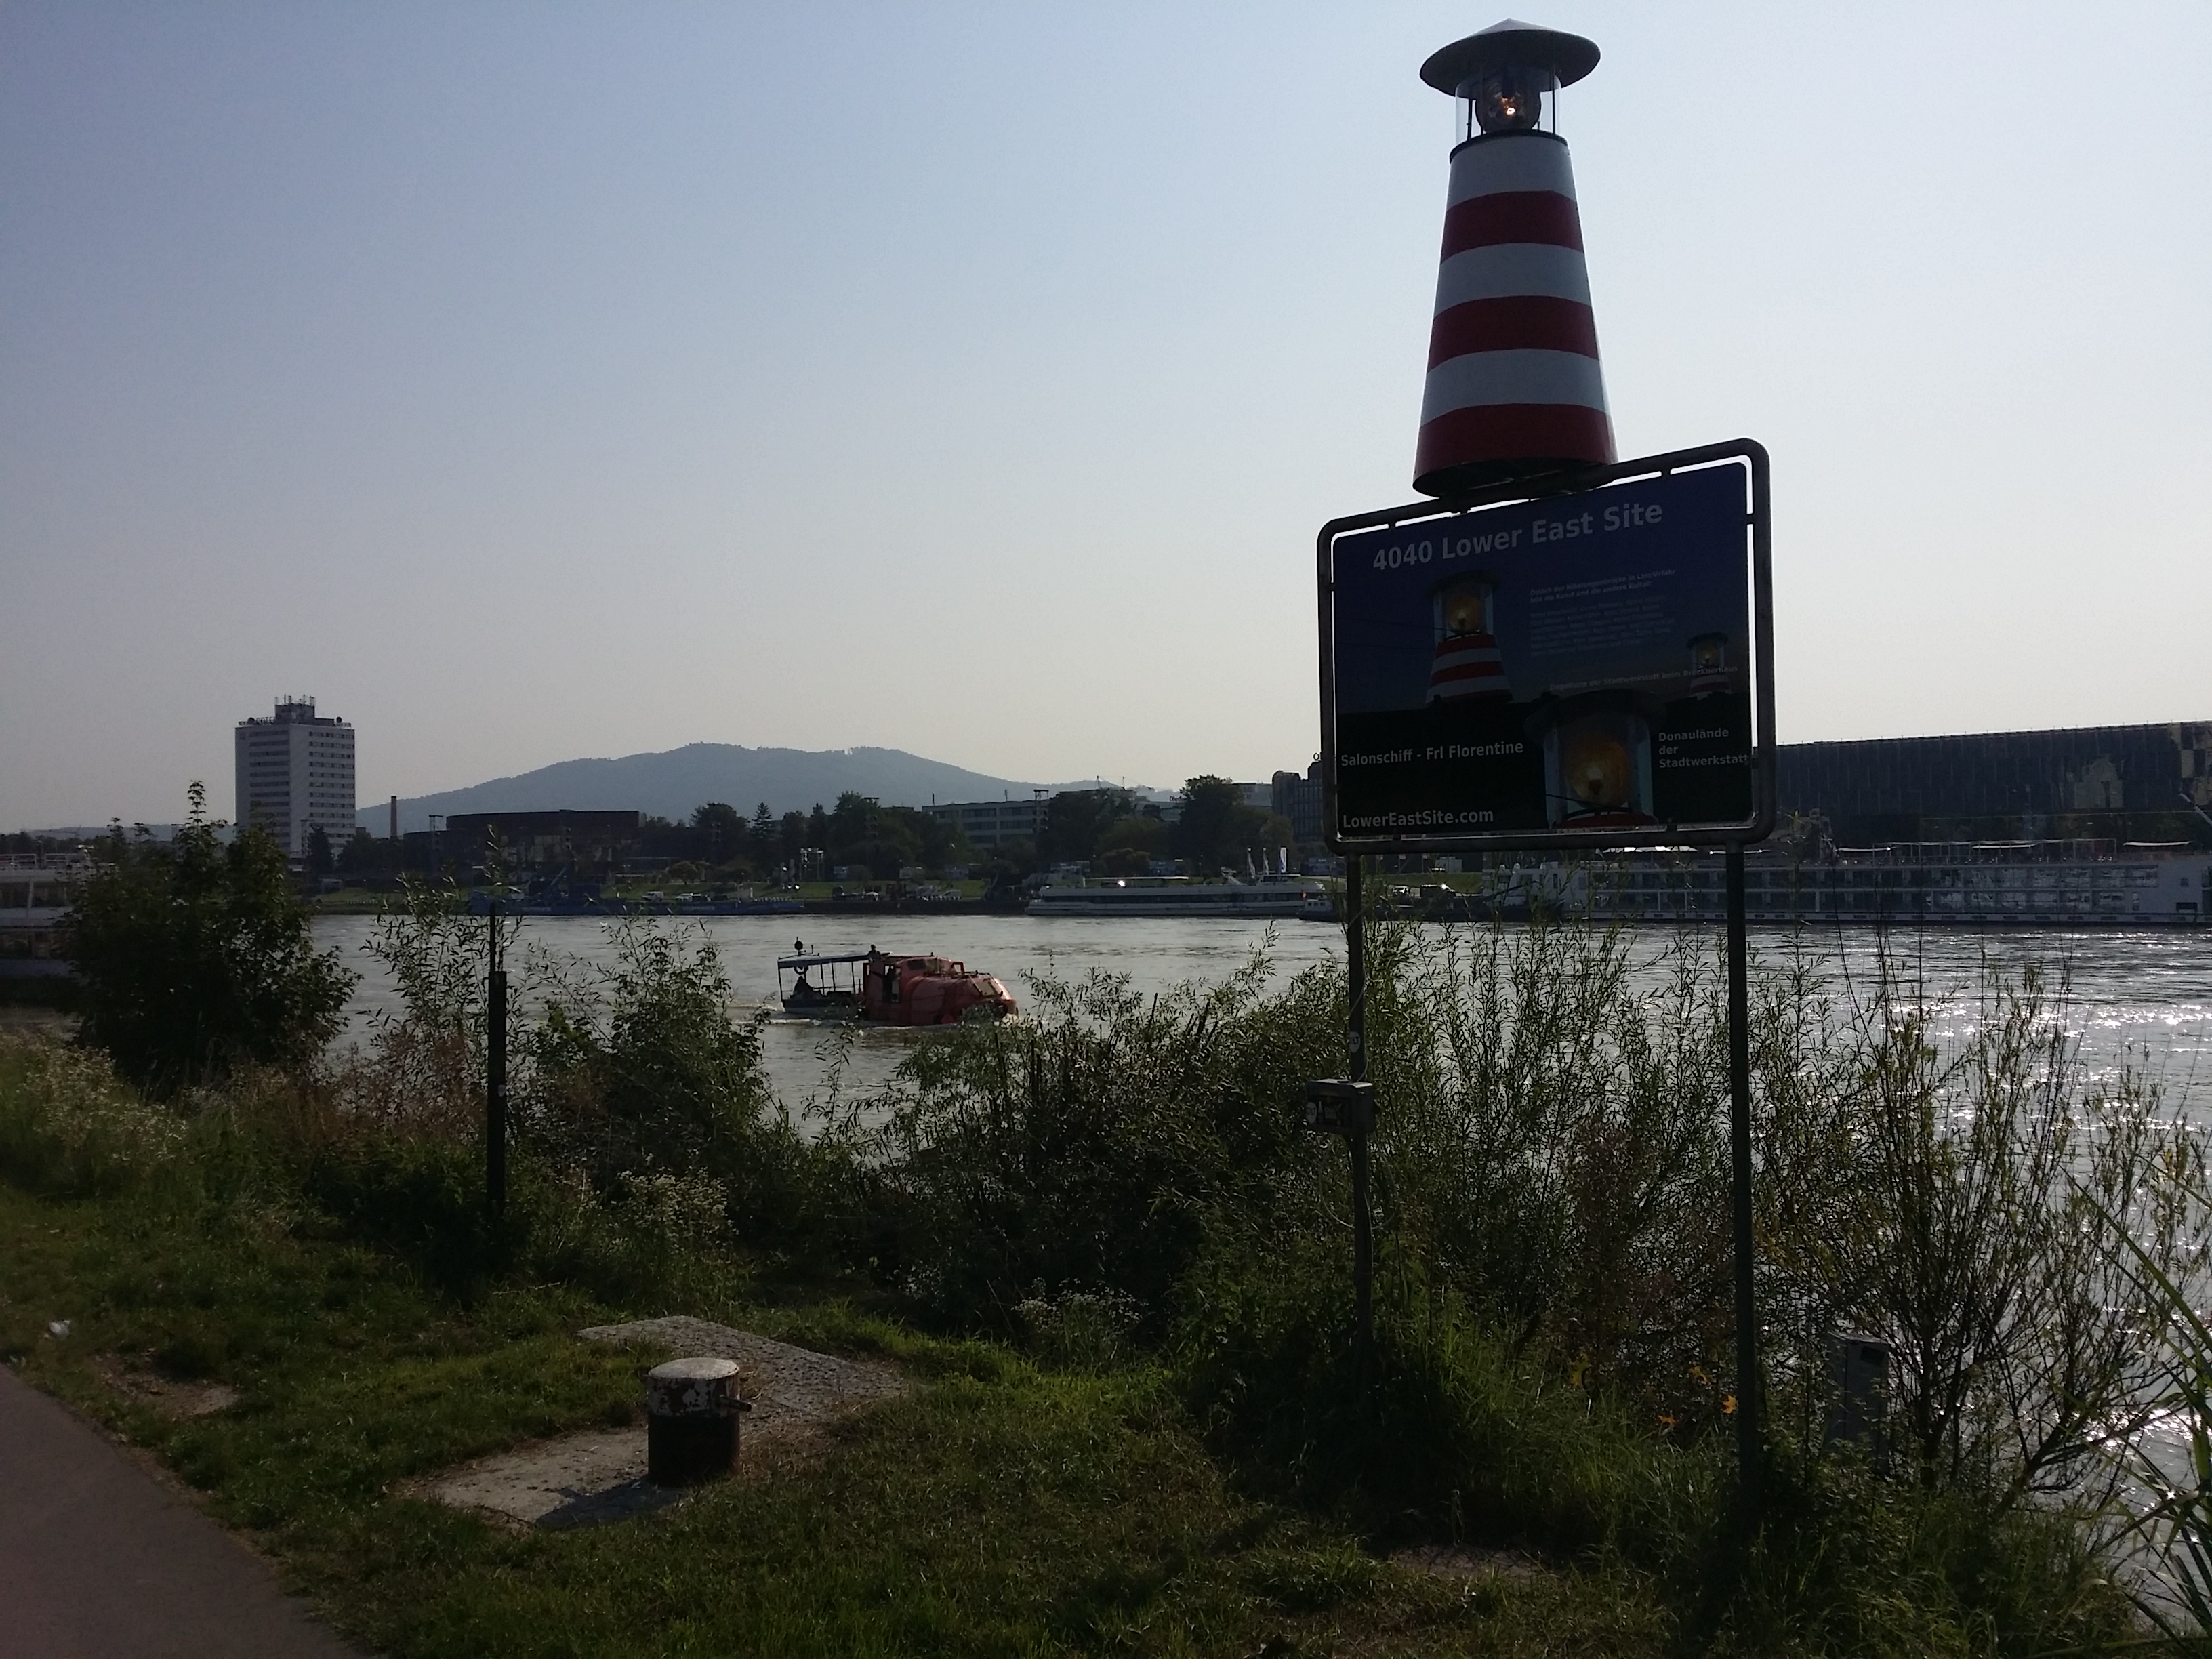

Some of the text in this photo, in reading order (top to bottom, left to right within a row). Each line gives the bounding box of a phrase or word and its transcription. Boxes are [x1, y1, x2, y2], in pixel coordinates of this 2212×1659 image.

[1373, 503, 1662, 571] 4040 Lower East Site
[1658, 728, 1729, 742] Donaulände
[1341, 749, 1413, 766] Salonschiff
[1427, 745, 1444, 760] Frl
[1449, 741, 1524, 758] Florentine
[1658, 745, 1679, 755] der
[1659, 754, 1749, 769] Stadtwerkstatt
[1343, 810, 1494, 829] LowerEastSite.com
